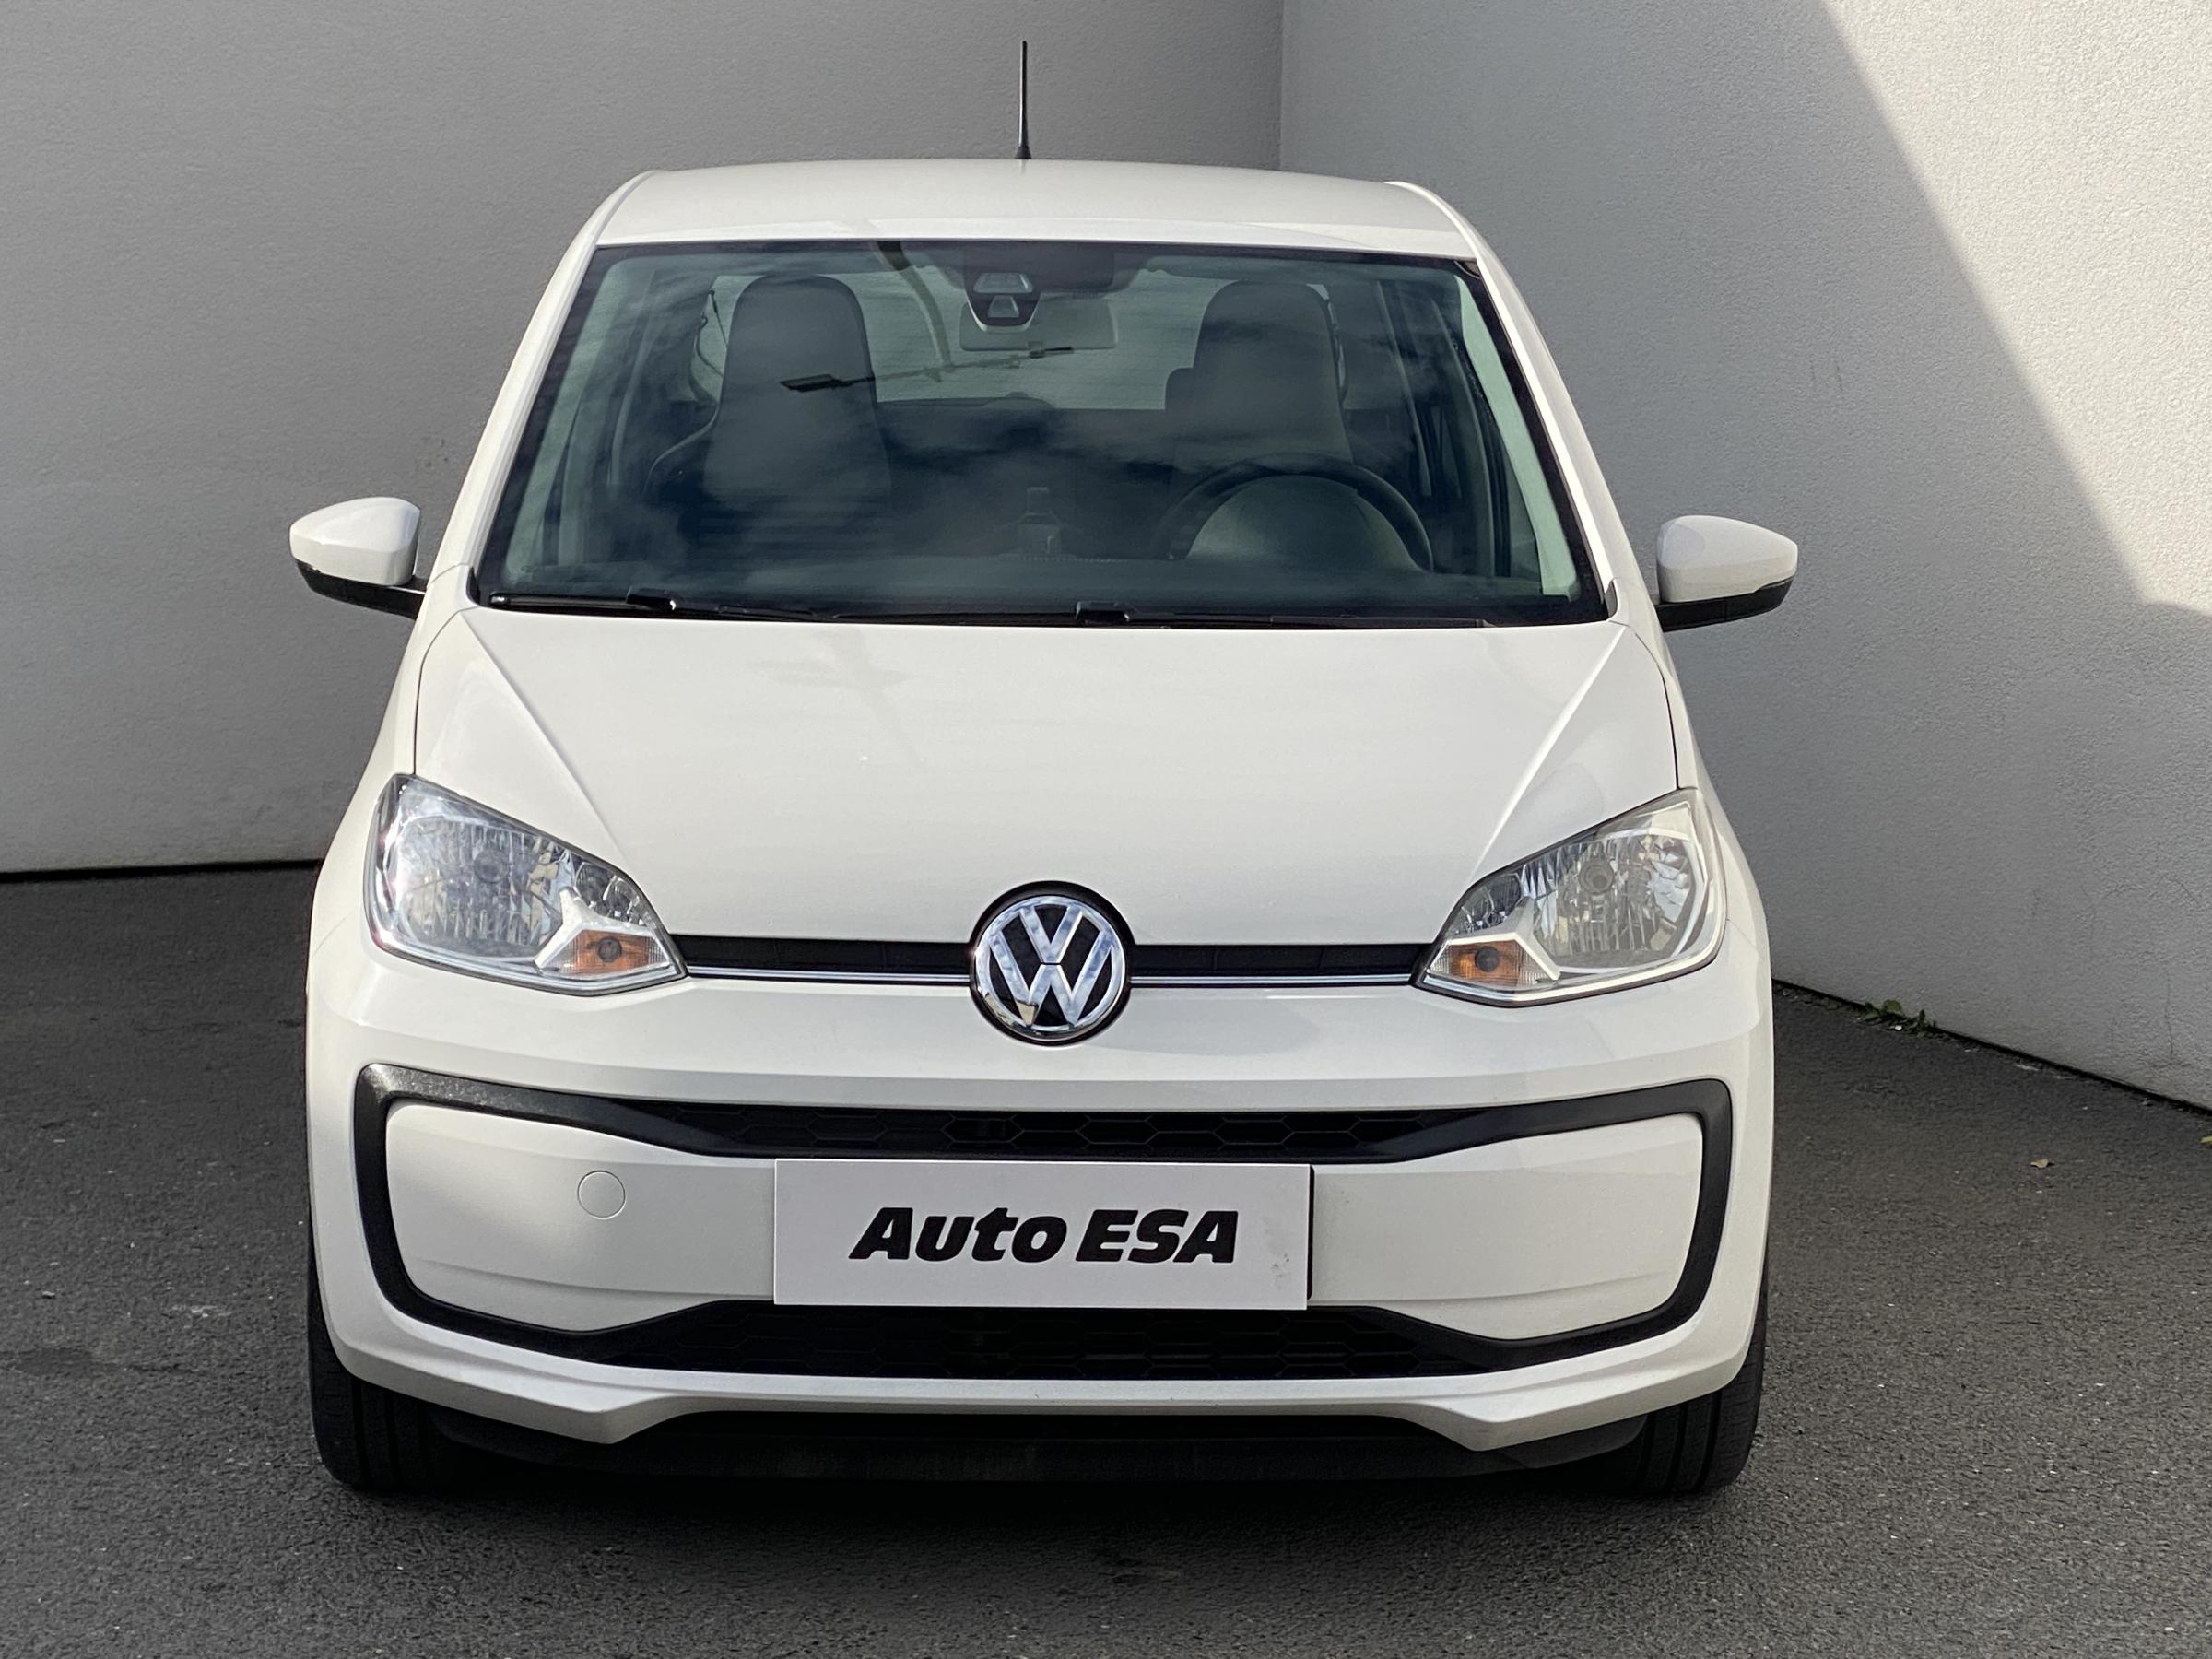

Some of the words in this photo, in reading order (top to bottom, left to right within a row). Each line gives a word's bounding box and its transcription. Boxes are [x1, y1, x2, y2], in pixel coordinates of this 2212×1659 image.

[985, 902, 1117, 1028] VW
[848, 1206, 1068, 1264] Auto
[1075, 1208, 1239, 1264] ESA
